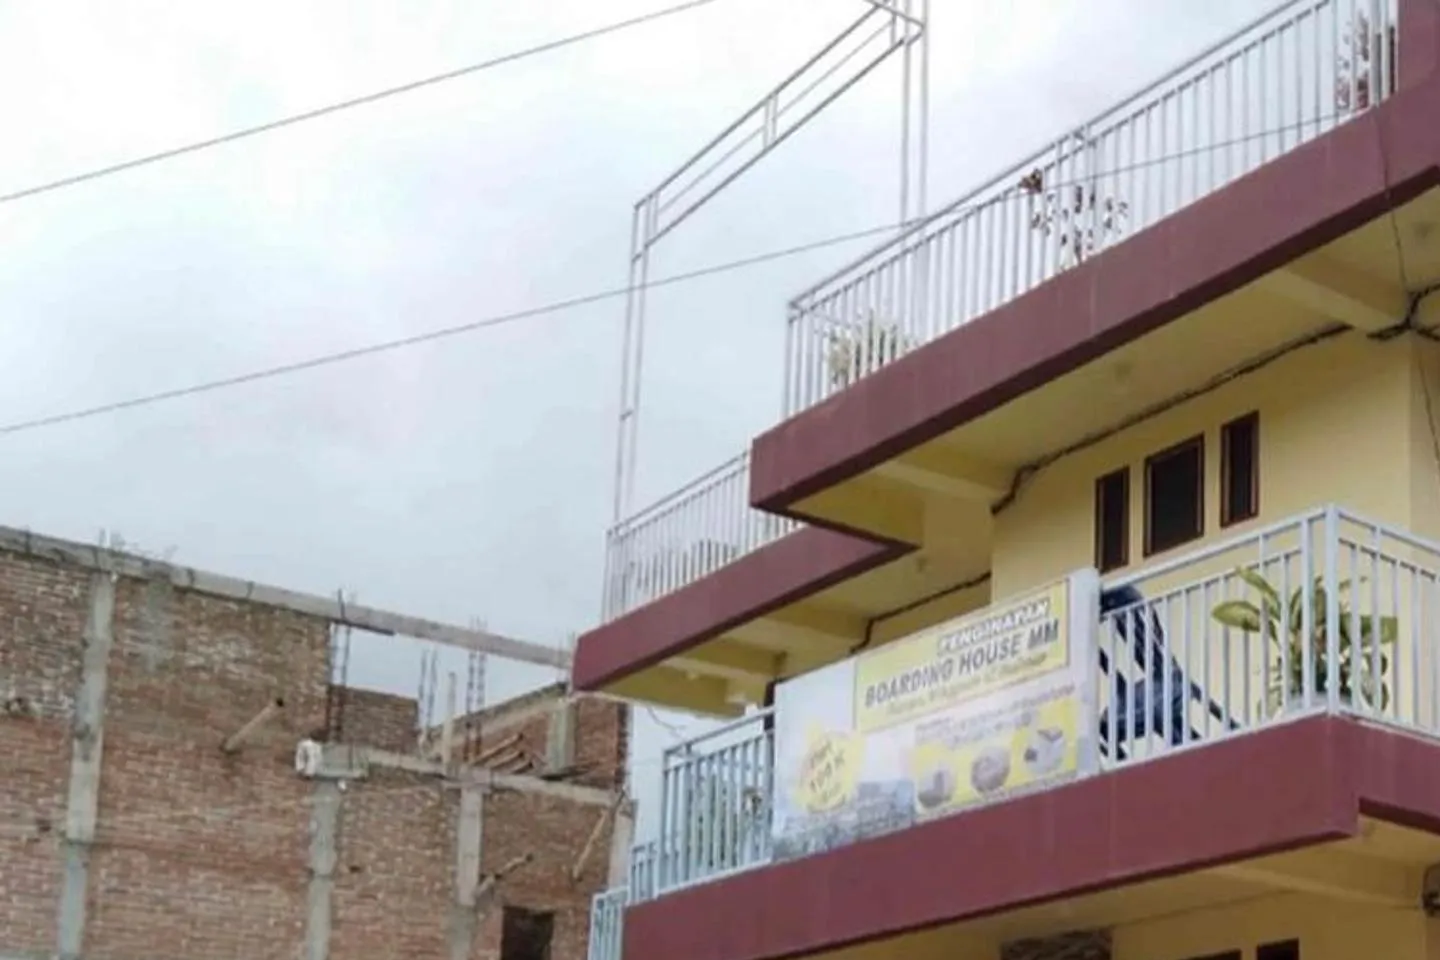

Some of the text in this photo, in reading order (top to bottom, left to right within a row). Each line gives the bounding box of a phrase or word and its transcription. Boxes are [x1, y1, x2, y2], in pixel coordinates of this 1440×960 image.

[865, 657, 953, 707] BOARDING
[958, 635, 1022, 675] HOUSE
[1027, 620, 1059, 650] MM
